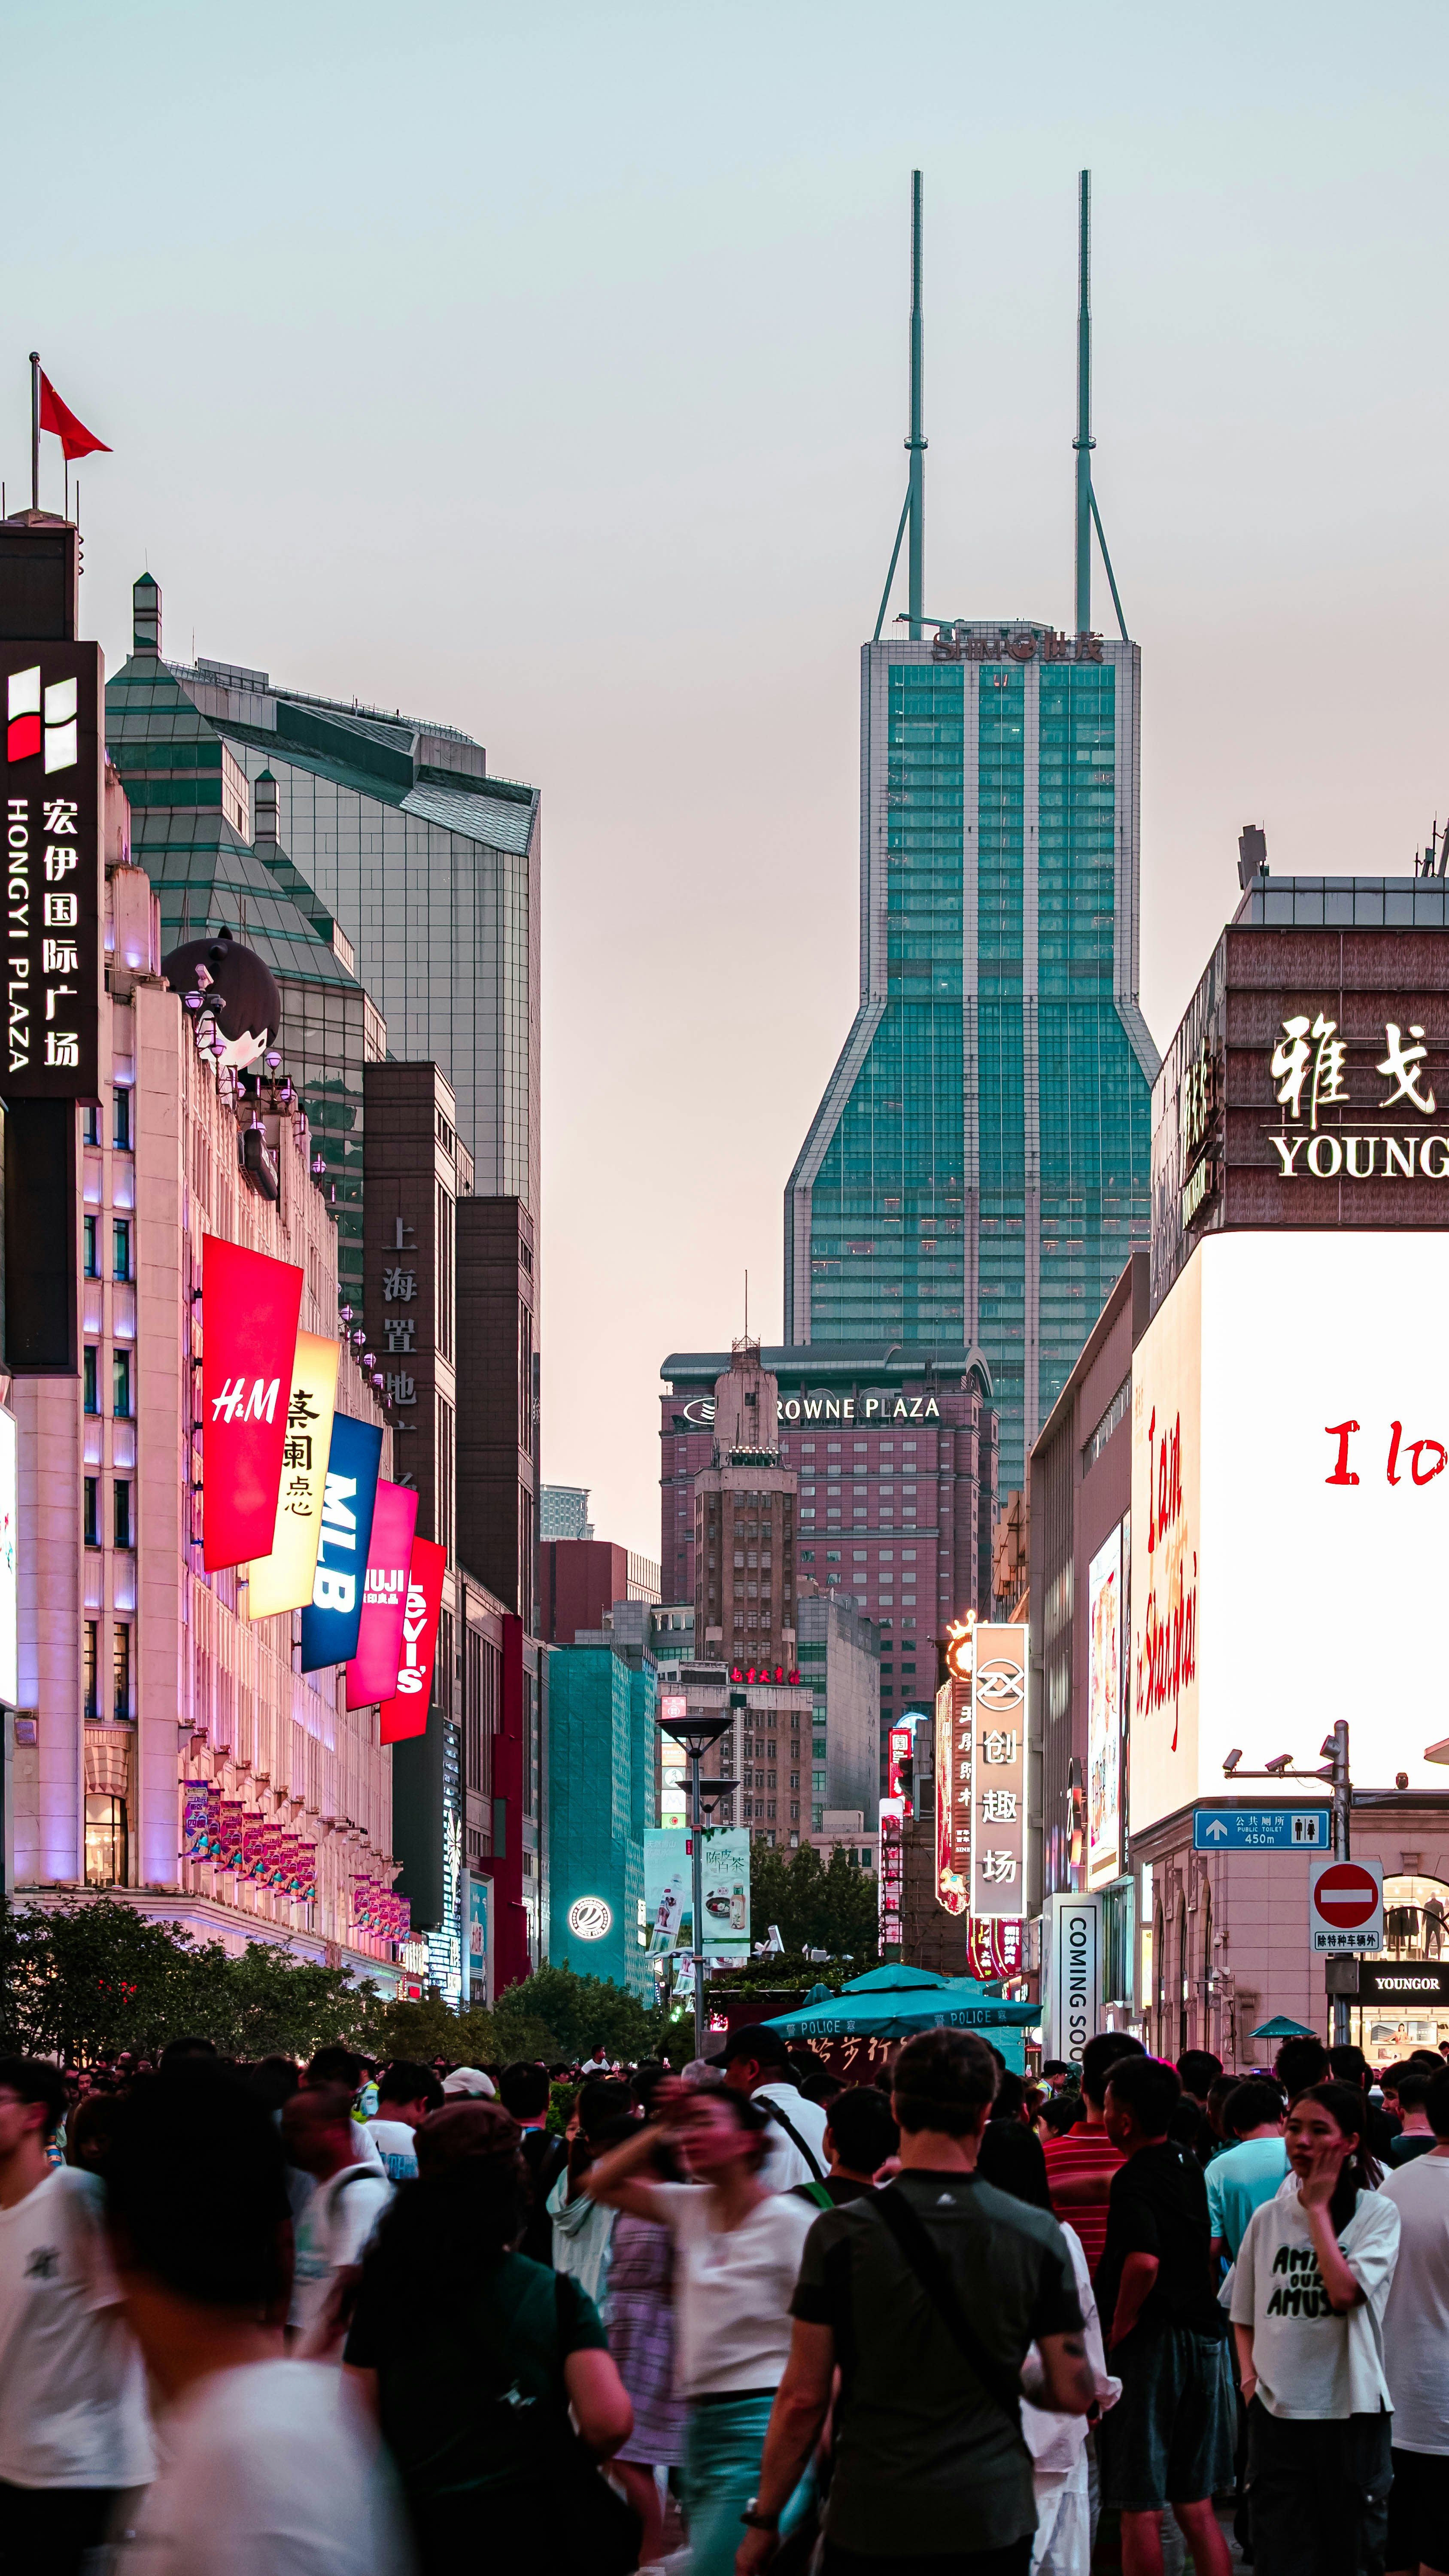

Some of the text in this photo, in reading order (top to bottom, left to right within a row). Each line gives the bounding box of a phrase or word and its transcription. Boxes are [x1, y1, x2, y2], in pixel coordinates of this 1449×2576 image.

[1044, 631, 1105, 662] 世茂
[7, 800, 29, 1072] HONGYI PLAZA
[43, 799, 79, 1068] 宏伊国际广场
[1270, 1012, 1437, 1131] 雅戈
[382, 1217, 418, 1430] 上海置地
[212, 1378, 280, 1424] H&M
[866, 1397, 940, 1418] PLAZA
[1325, 1420, 1360, 1485] I
[313, 1472, 357, 1613] MLB
[982, 1729, 1018, 1883] 创趣场
[1236, 1816, 1285, 1826] 公共厕所
[1245, 1834, 1274, 1844] 450m
[1317, 1935, 1376, 1947] 除特种车辆外
[1069, 1917, 1087, 2008] COMING
[1375, 1978, 1440, 1990] YOUNGOR
[801, 2020, 841, 2033] POLICE
[847, 2020, 856, 2032] 察
[951, 2011, 992, 2025] POLICE
[998, 2010, 1007, 2021] 察
[1267, 2288, 1347, 2318] AMUS
